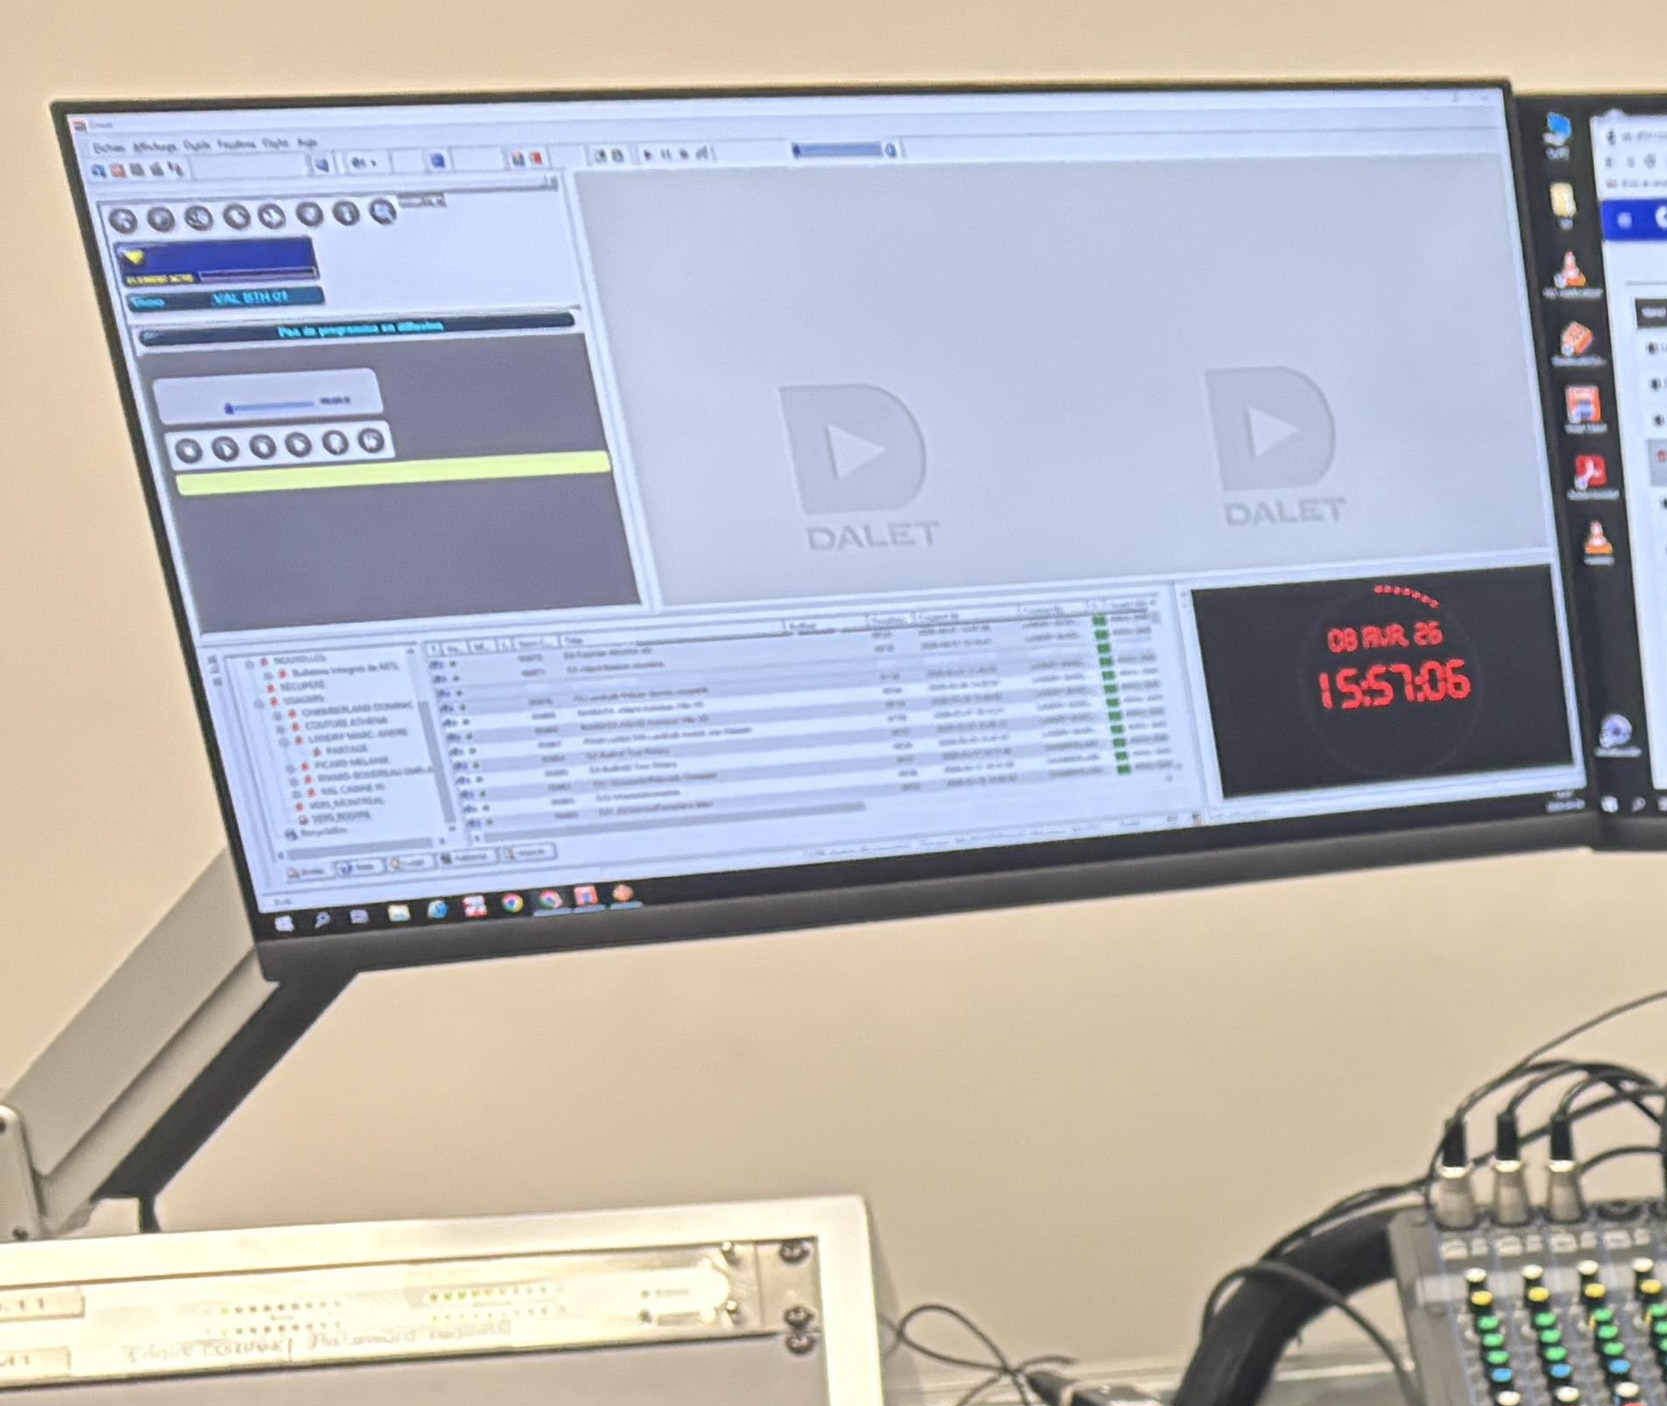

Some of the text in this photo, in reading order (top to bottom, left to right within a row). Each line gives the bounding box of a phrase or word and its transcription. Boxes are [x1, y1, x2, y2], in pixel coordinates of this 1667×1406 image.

[1224, 496, 1348, 526] DALET
[806, 520, 940, 551] DALET
[1327, 627, 1358, 653] 08
[1361, 623, 1410, 650] AVR
[1318, 658, 1471, 710] 15:57:06
